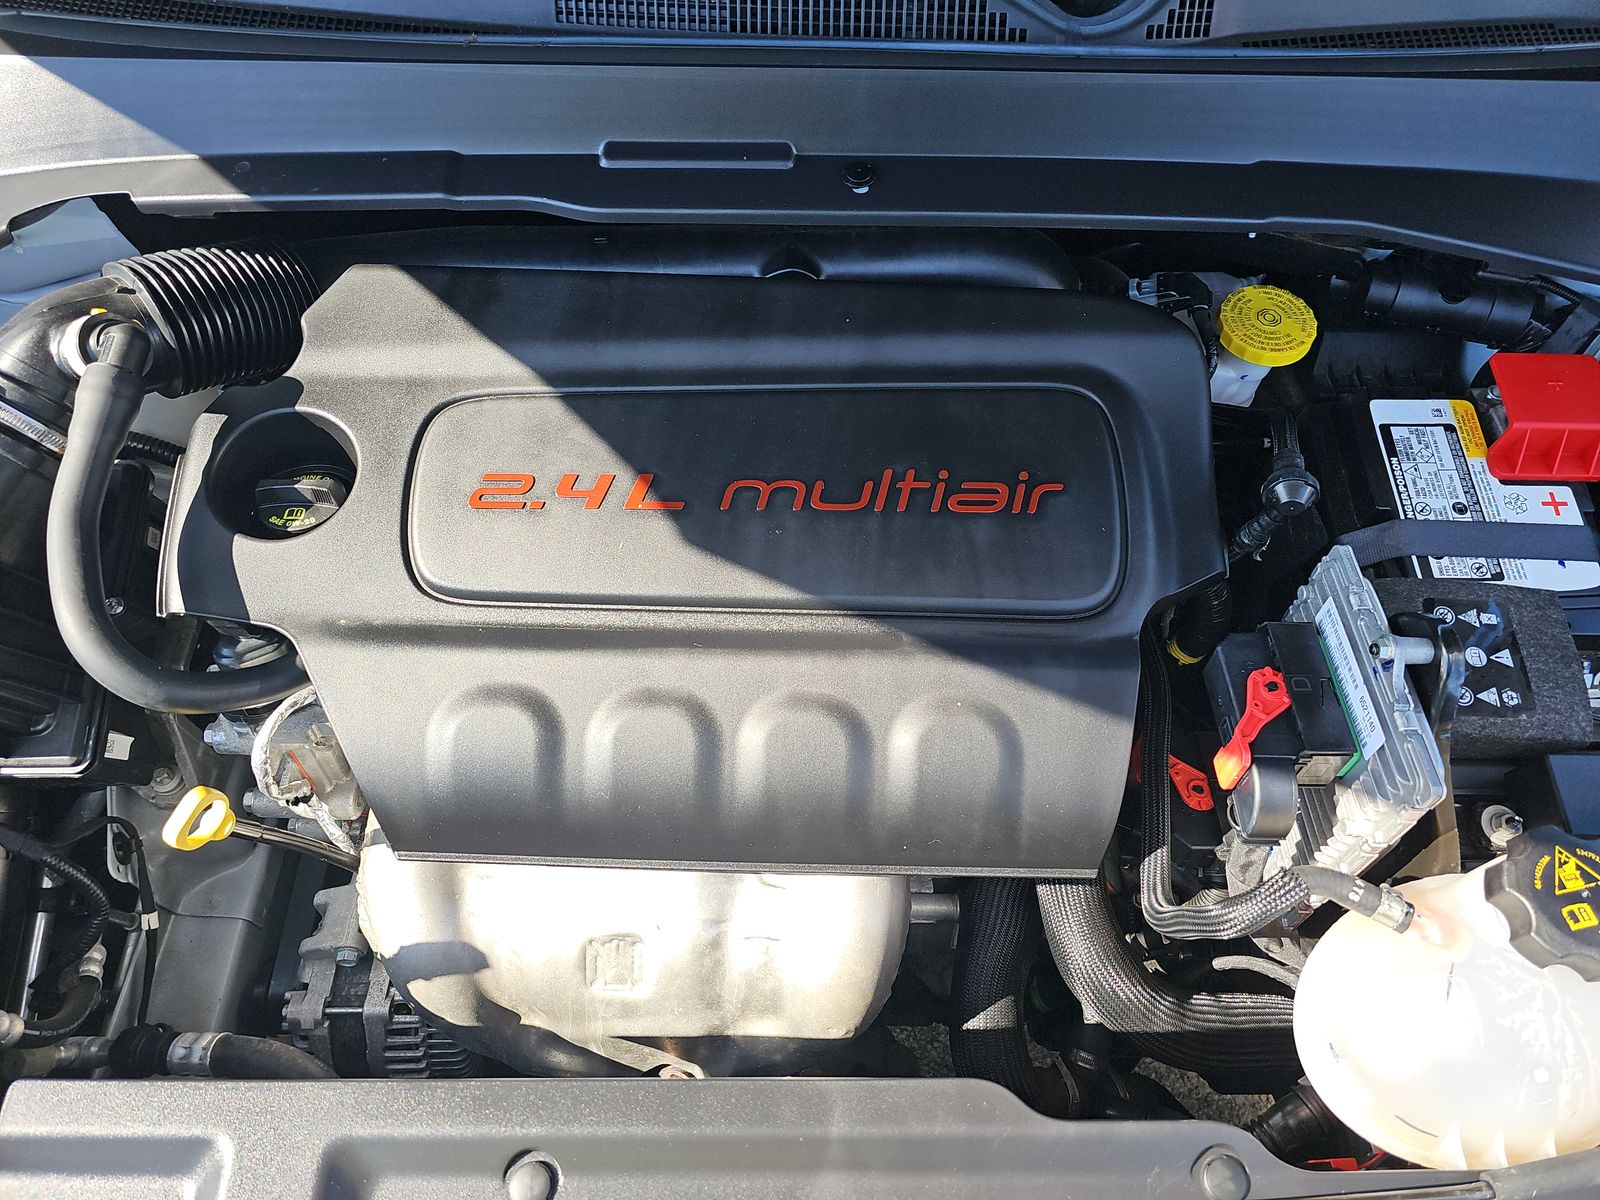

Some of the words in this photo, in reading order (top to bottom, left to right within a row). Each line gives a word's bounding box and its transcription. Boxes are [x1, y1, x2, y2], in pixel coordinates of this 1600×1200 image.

[720, 468, 1065, 515] multiair
[1390, 457, 1414, 518] NGER/POISON
[269, 516, 286, 526] SAE
[286, 516, 316, 527] 0W-20
[1358, 695, 1376, 734] 6521140
